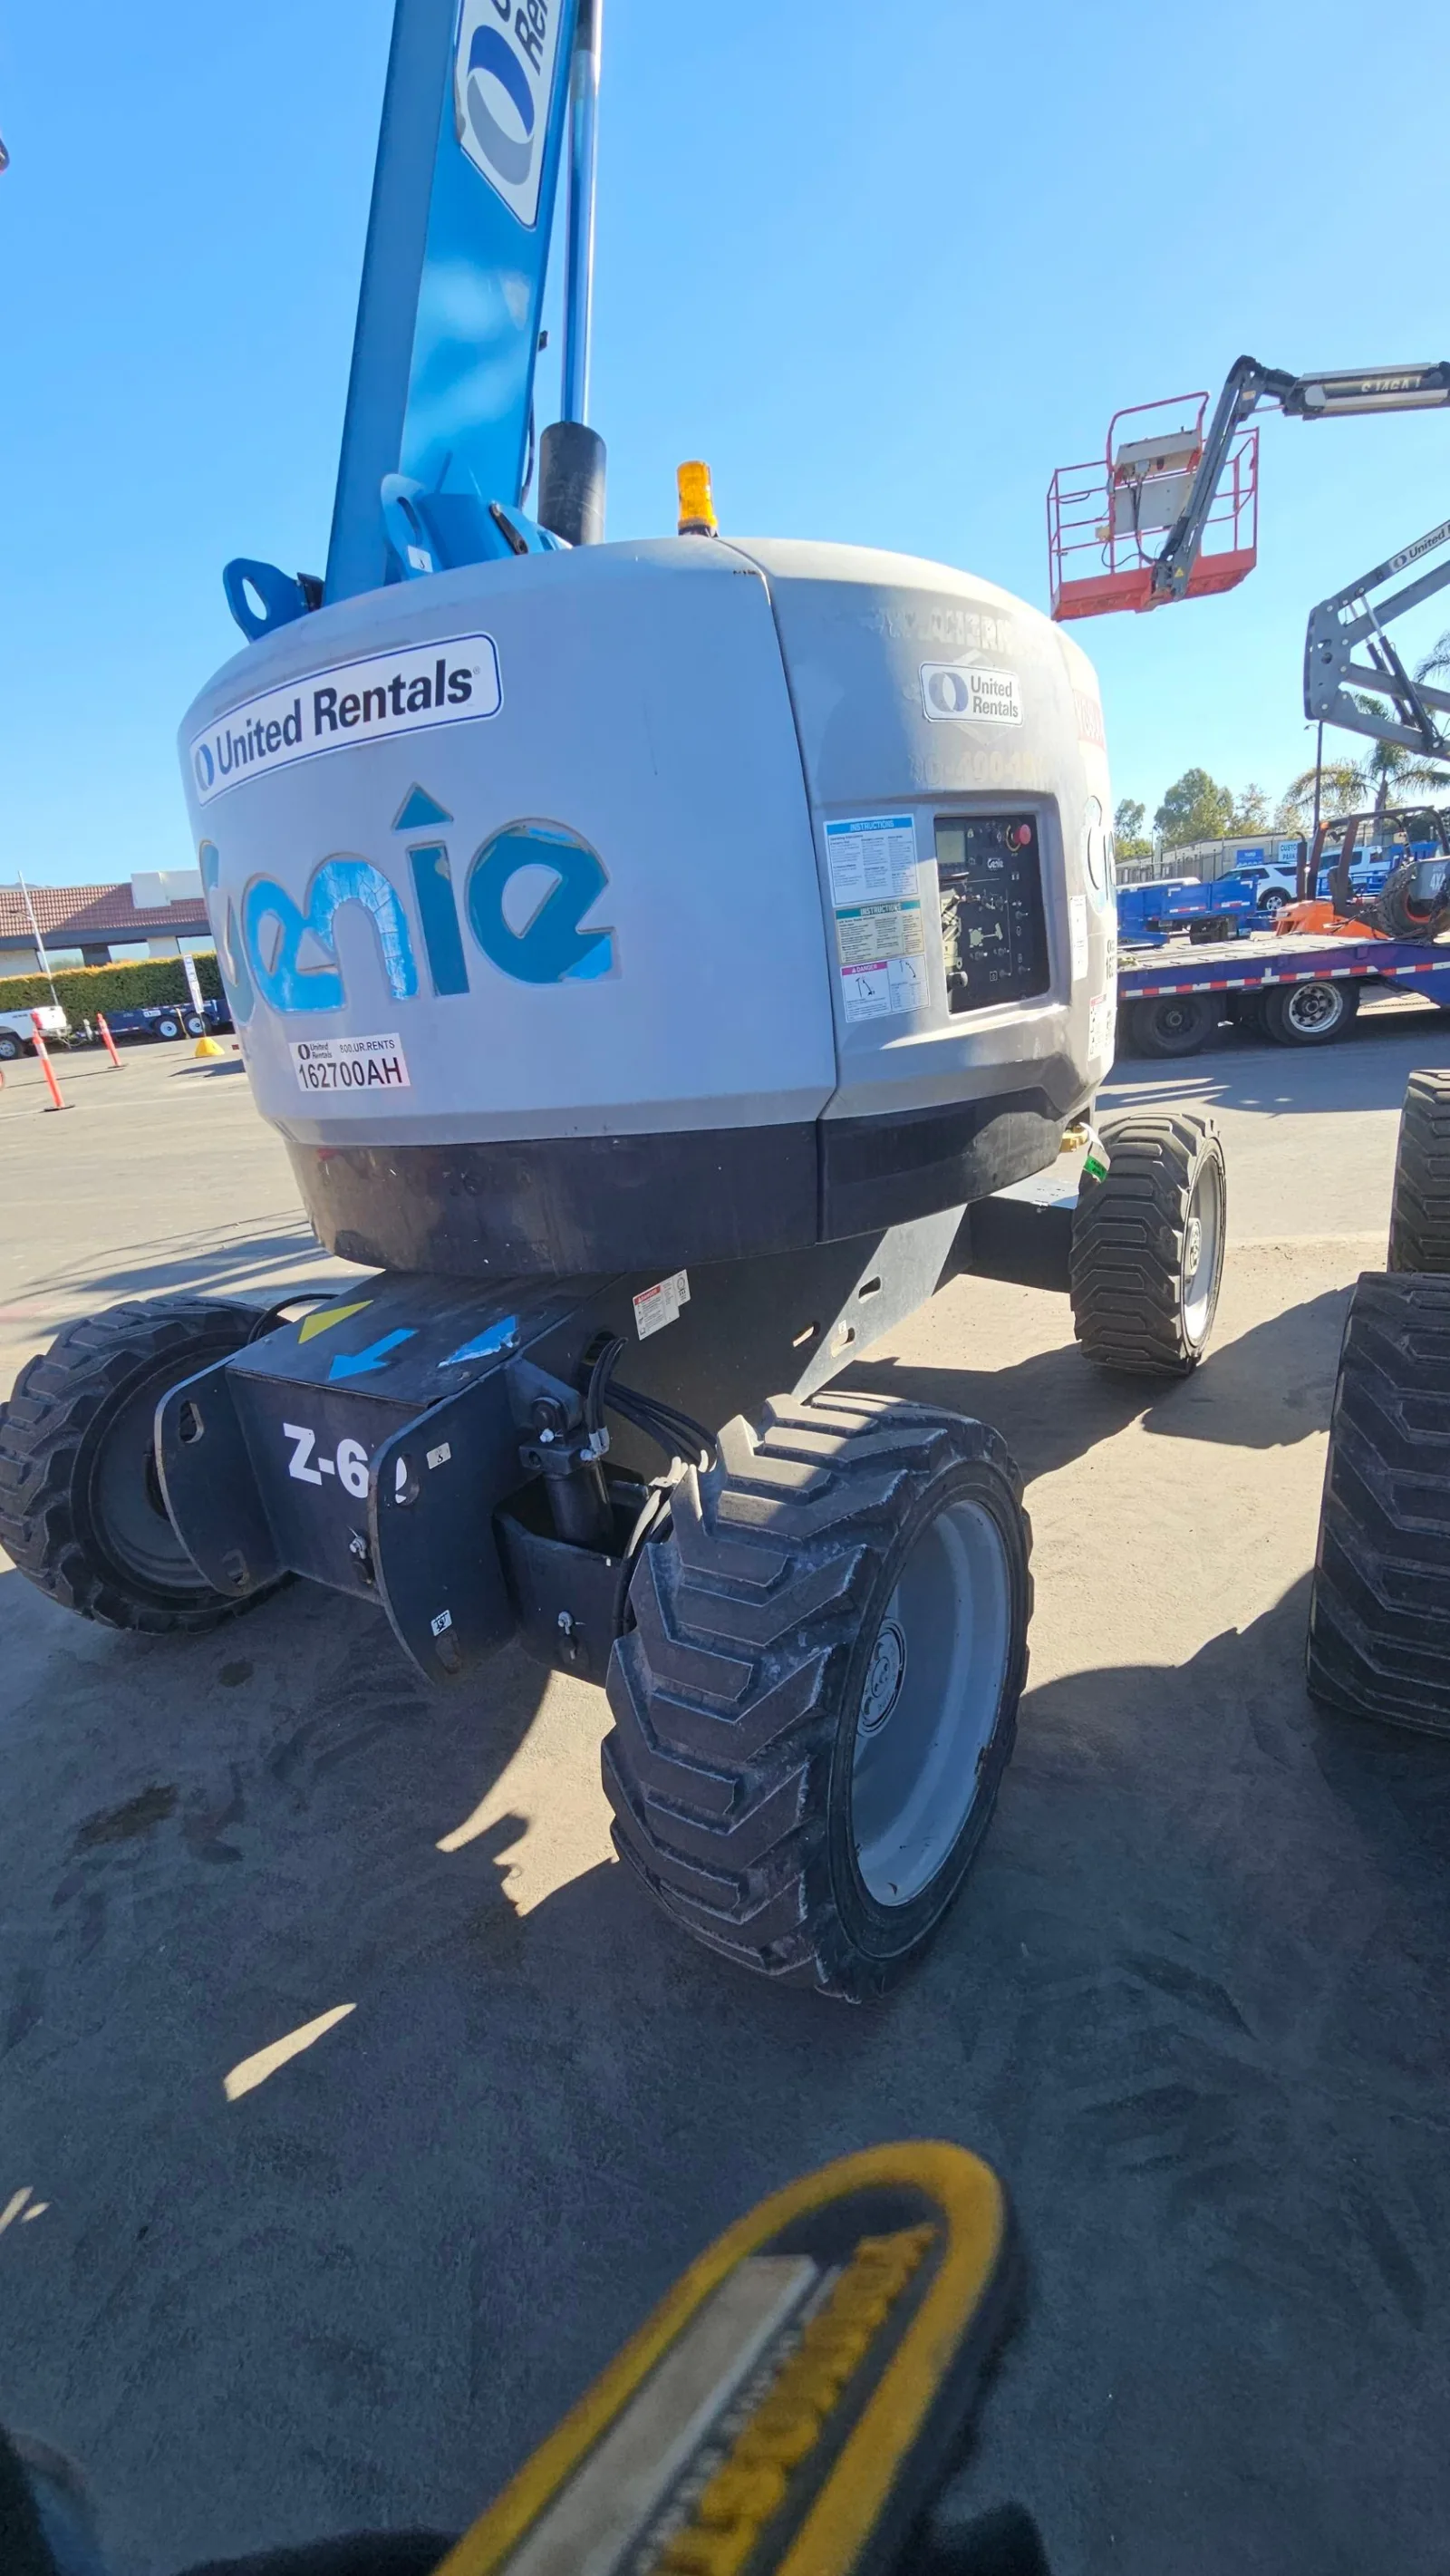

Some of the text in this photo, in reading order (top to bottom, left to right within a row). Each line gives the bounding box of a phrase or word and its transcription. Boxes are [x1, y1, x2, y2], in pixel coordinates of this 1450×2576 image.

[1409, 528, 1445, 558] United
[970, 674, 1013, 698] United
[972, 695, 1019, 719] Rentals
[216, 658, 473, 776] United Rentals
[850, 819, 894, 832] INSTRUCTIONS
[1280, 843, 1297, 852] CUSTO
[856, 964, 878, 973] DANGER
[310, 1039, 395, 1053] United 800.UR.RENTS
[312, 1051, 333, 1060] Rentals
[299, 1057, 403, 1089] 162700AH
